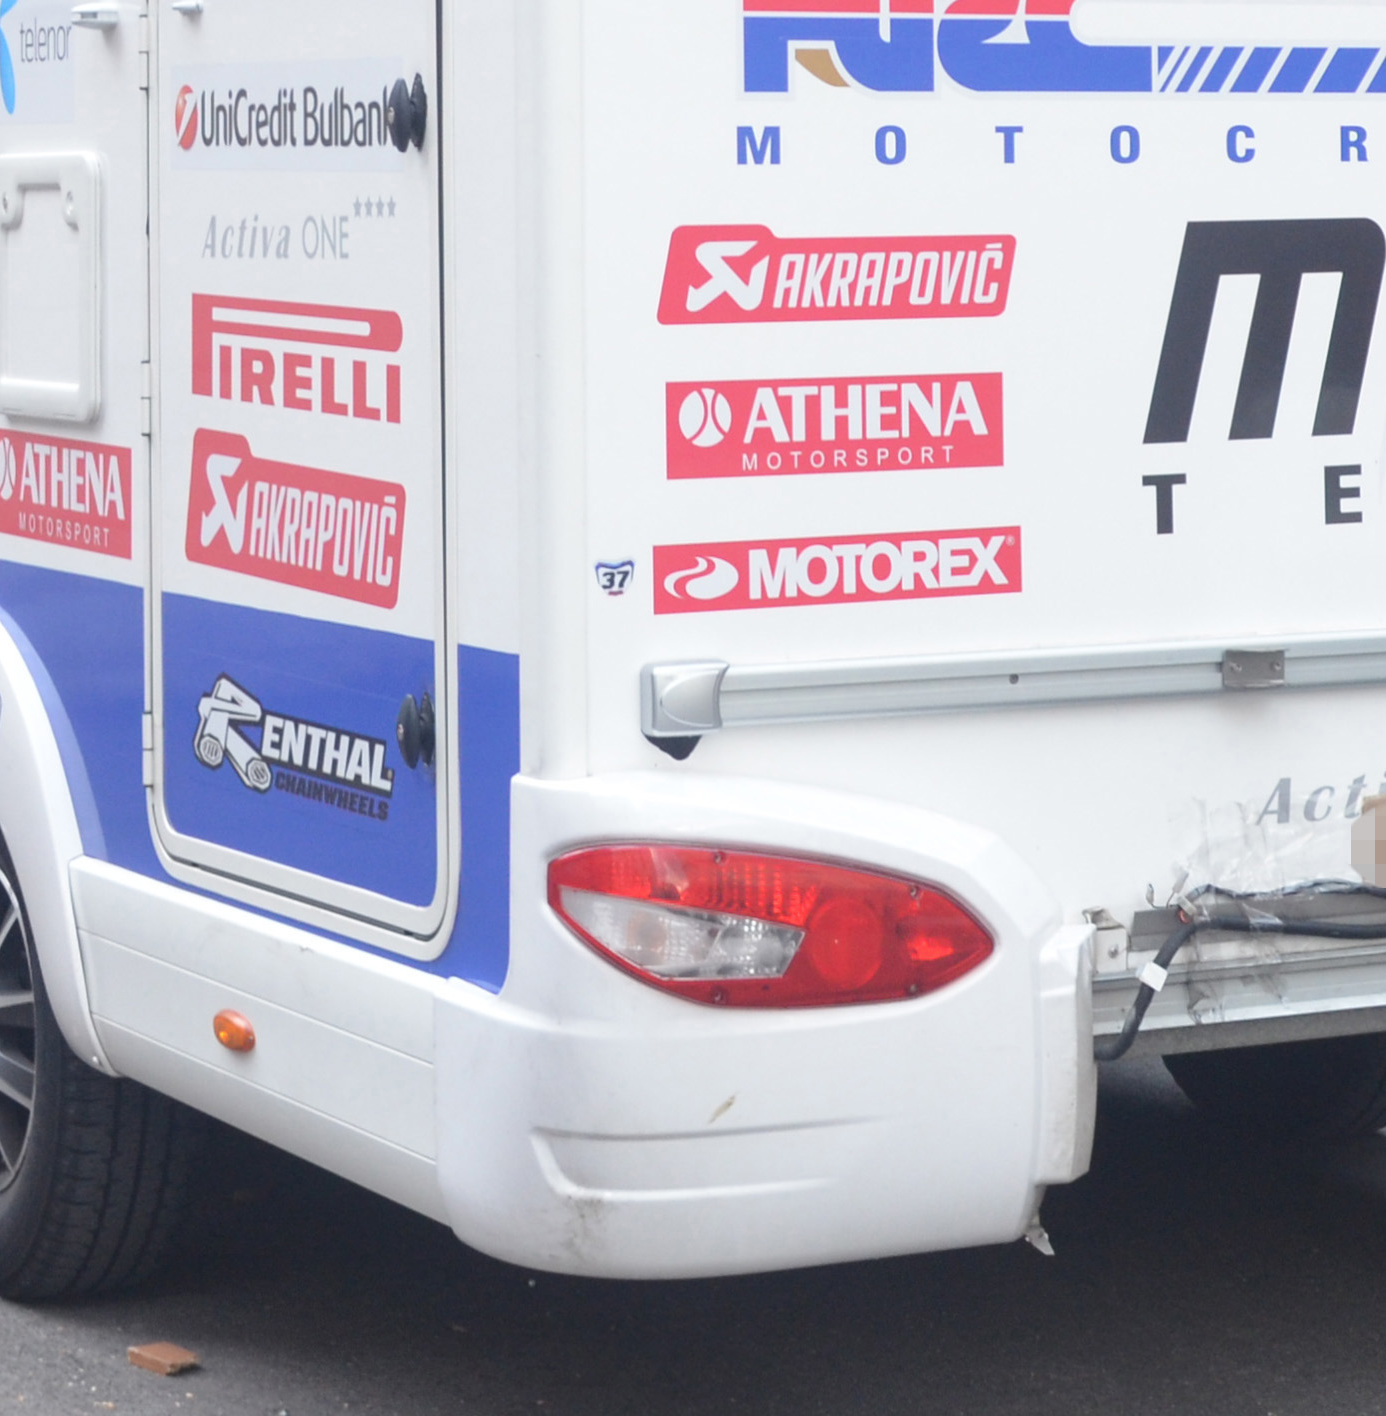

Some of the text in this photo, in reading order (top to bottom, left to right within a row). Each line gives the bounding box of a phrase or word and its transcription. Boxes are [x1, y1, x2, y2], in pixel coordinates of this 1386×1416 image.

[19, 15, 73, 65] telenor
[200, 86, 297, 148] UniCredit
[200, 213, 350, 261] Activa ONE
[191, 291, 404, 425] PIRELLI
[742, 380, 989, 444] ATHENA
[19, 441, 126, 521] ATHENA
[741, 445, 955, 473] MOTORSPORT
[18, 511, 111, 549] MOTORSPORT
[601, 569, 630, 590] 37
[747, 533, 1010, 602] MOTOREX
[192, 671, 395, 796] RENTHAL
[274, 770, 390, 822] CHAINWHEELS
